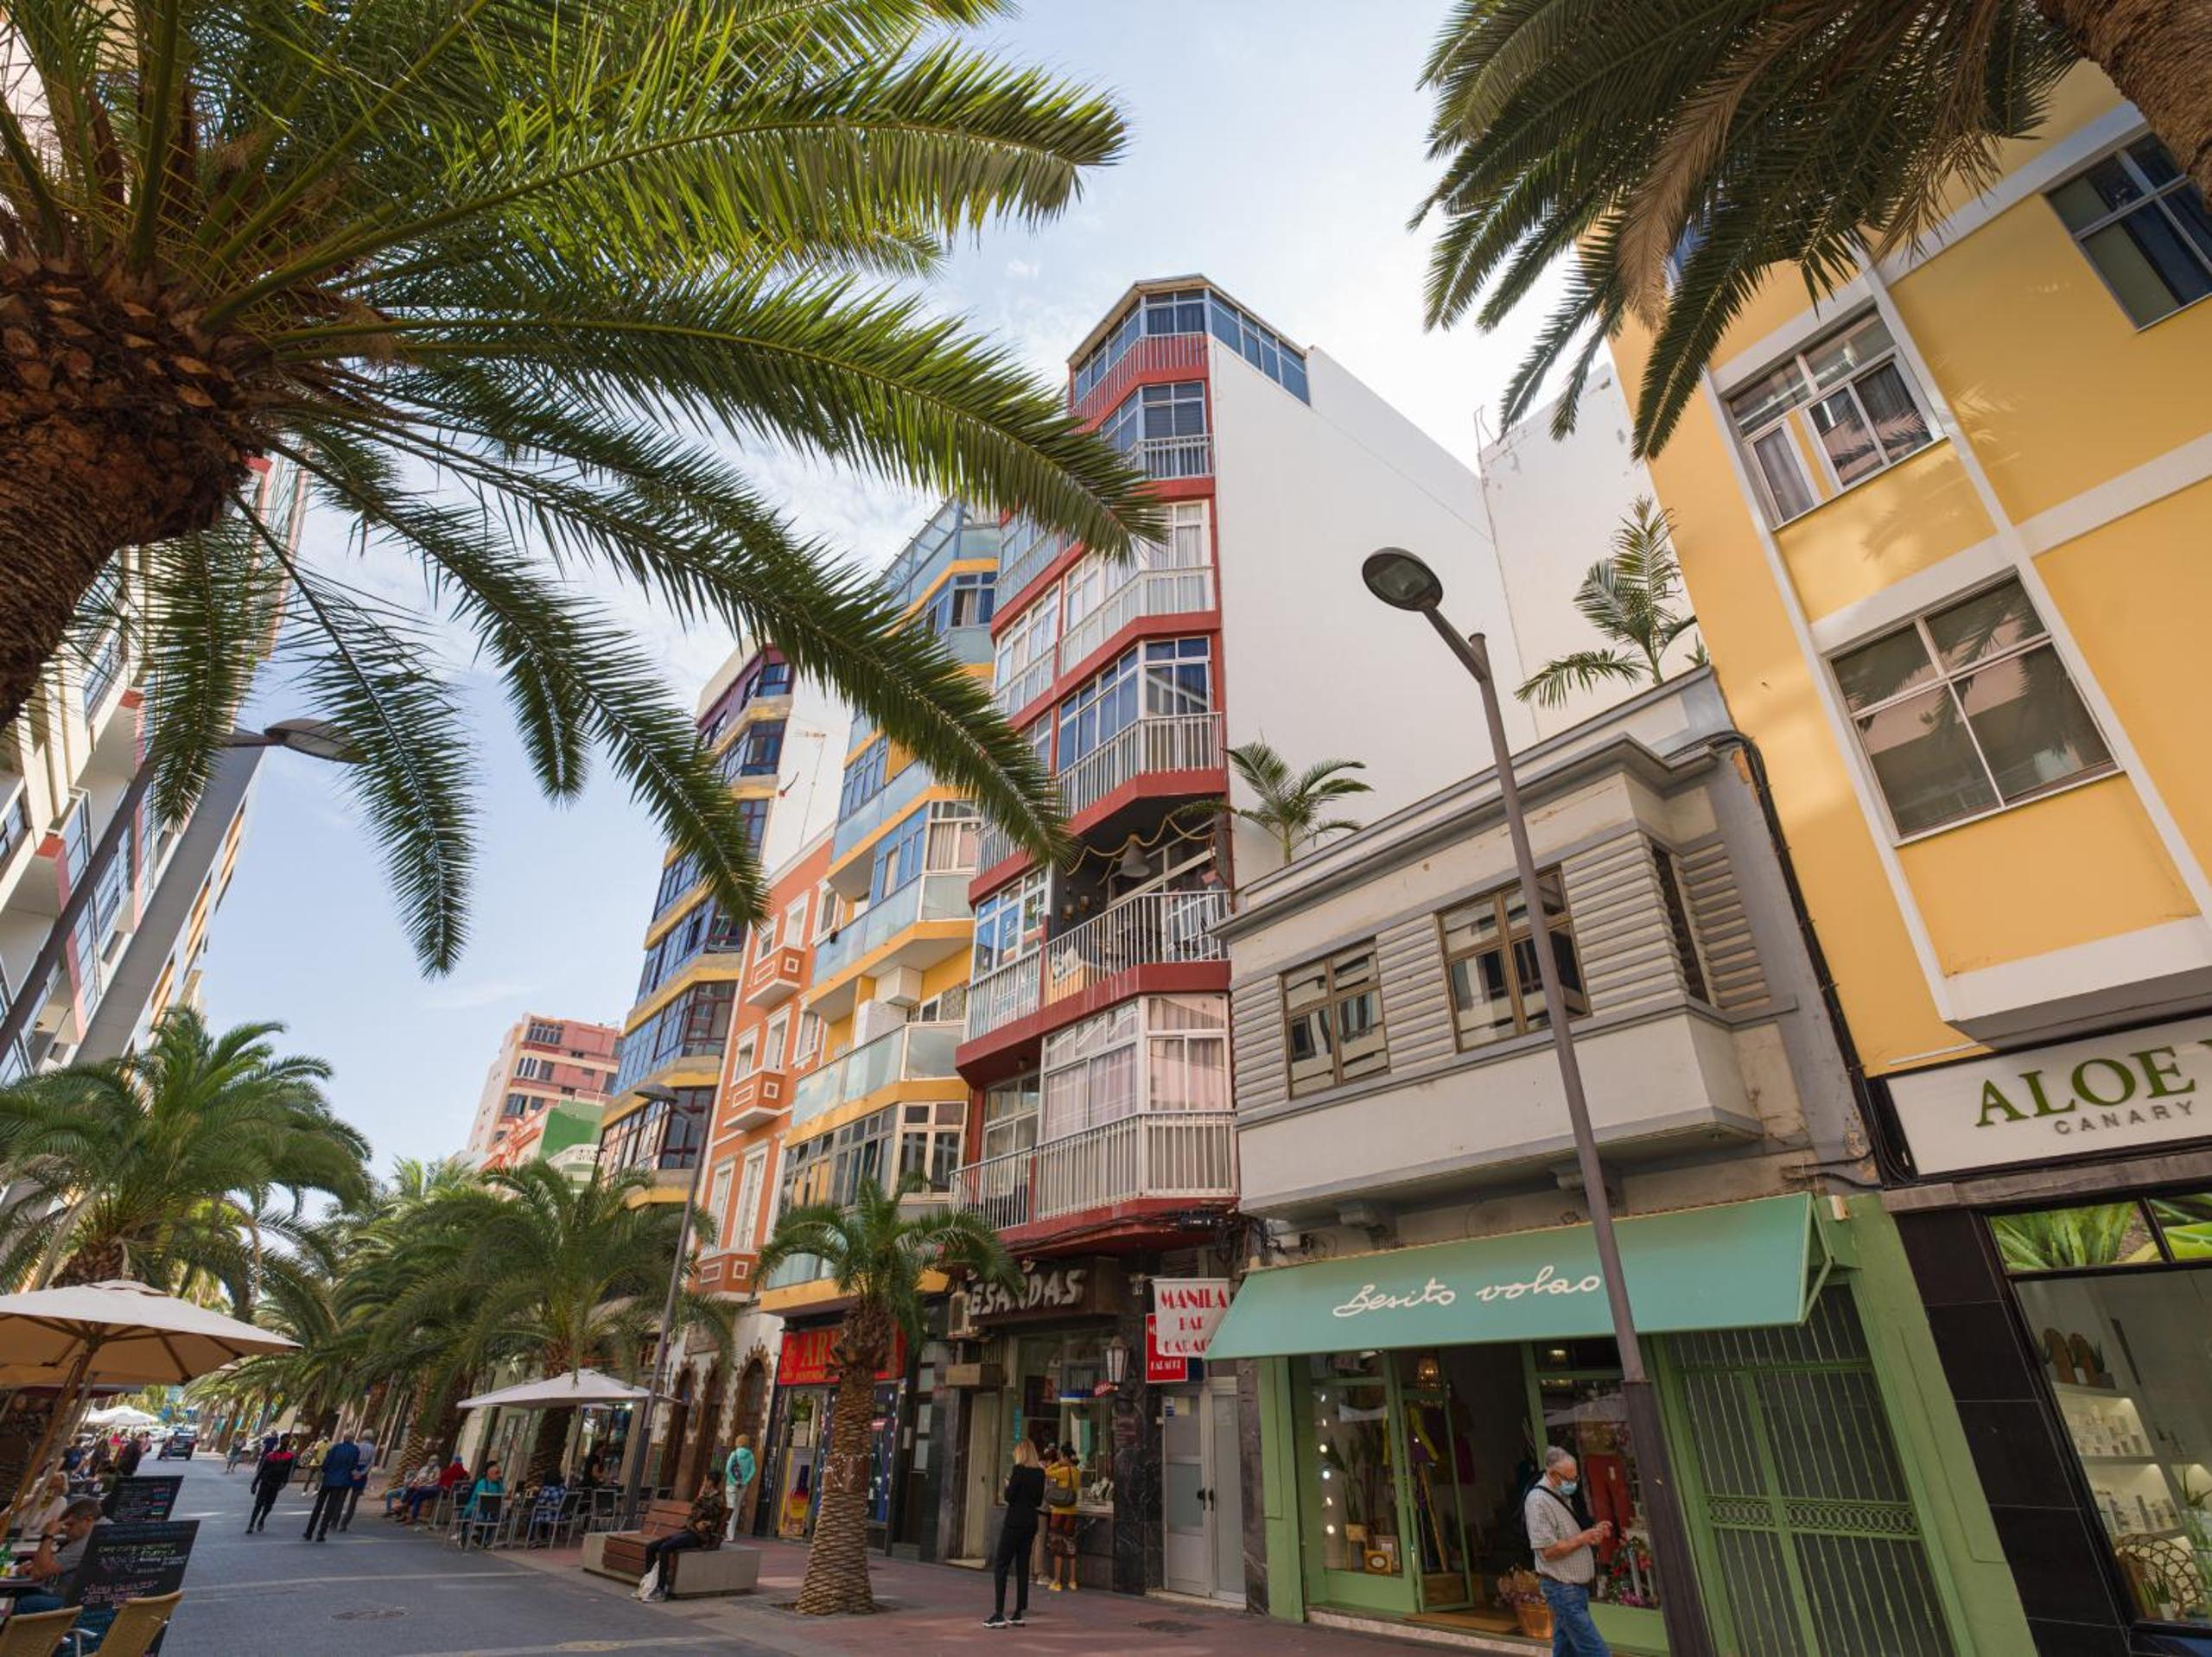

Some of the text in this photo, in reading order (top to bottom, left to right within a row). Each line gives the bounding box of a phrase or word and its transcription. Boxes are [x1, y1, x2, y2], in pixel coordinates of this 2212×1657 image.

[1975, 1046, 2196, 1127] ALOE
[2053, 1100, 2193, 1135] CANARY
[1160, 1287, 1228, 1310] MANILA
[1332, 1265, 1600, 1317] Besito volao
